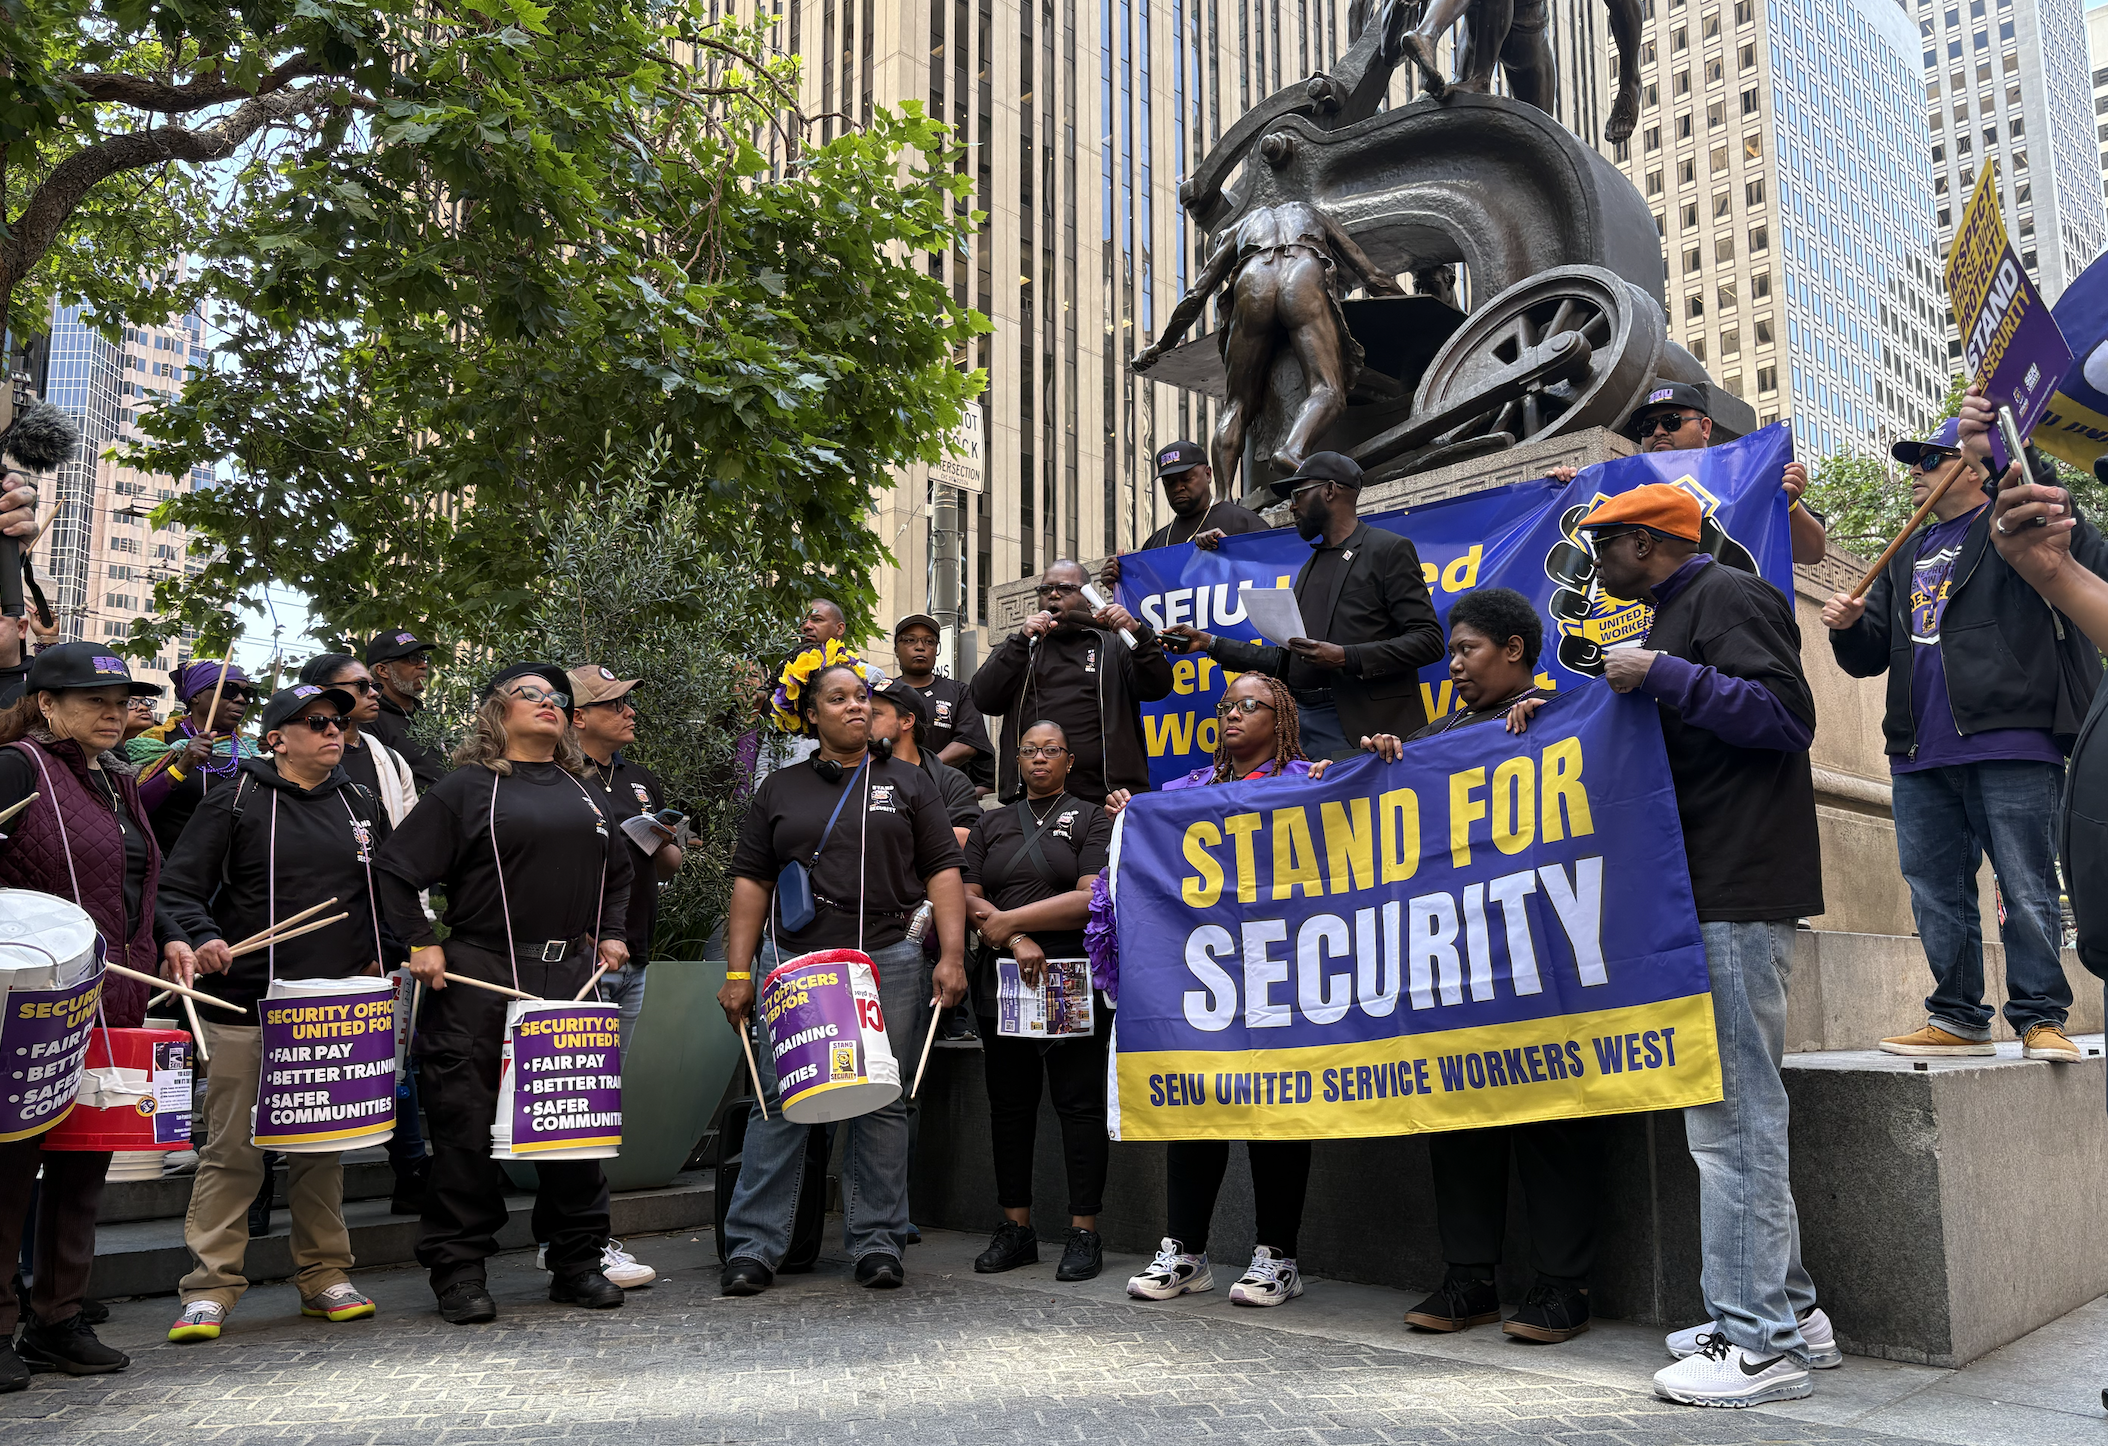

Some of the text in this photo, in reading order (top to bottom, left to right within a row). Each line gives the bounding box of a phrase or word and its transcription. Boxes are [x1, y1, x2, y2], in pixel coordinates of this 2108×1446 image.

[1949, 174, 1991, 298] RESPECT
[1954, 203, 1995, 311] THOSE WHO
[1959, 223, 2002, 332] PROTECT!
[1967, 258, 2018, 376] STAND
[1976, 282, 2031, 391] OR SECURITY
[1140, 580, 1253, 632] SEIU
[1599, 608, 1642, 631] UNITED
[1181, 736, 1596, 909] STAND FOR
[1182, 856, 1610, 1032] SECURITY
[18, 980, 104, 1019] SECURIT
[267, 1004, 351, 1025] SECURITY
[293, 1017, 392, 1040] UNITED FOR
[520, 1017, 603, 1037] SECURITY
[553, 1033, 613, 1049] UNITED
[775, 1023, 838, 1060] TRAINING
[31, 1030, 81, 1059] FAIR
[274, 1043, 353, 1063] FAIR PAY
[272, 1057, 395, 1086] BETTER TRAININ
[532, 1054, 606, 1073] FAIR PAY
[1149, 1027, 1679, 1108] SEIU UNITED SERVICE WORKERS WEST
[23, 1064, 83, 1104] SAFER
[271, 1090, 330, 1108] SAFER
[533, 1075, 597, 1095] BETTER
[270, 1096, 392, 1126] COMMUNITIES
[533, 1098, 589, 1117] SAFER
